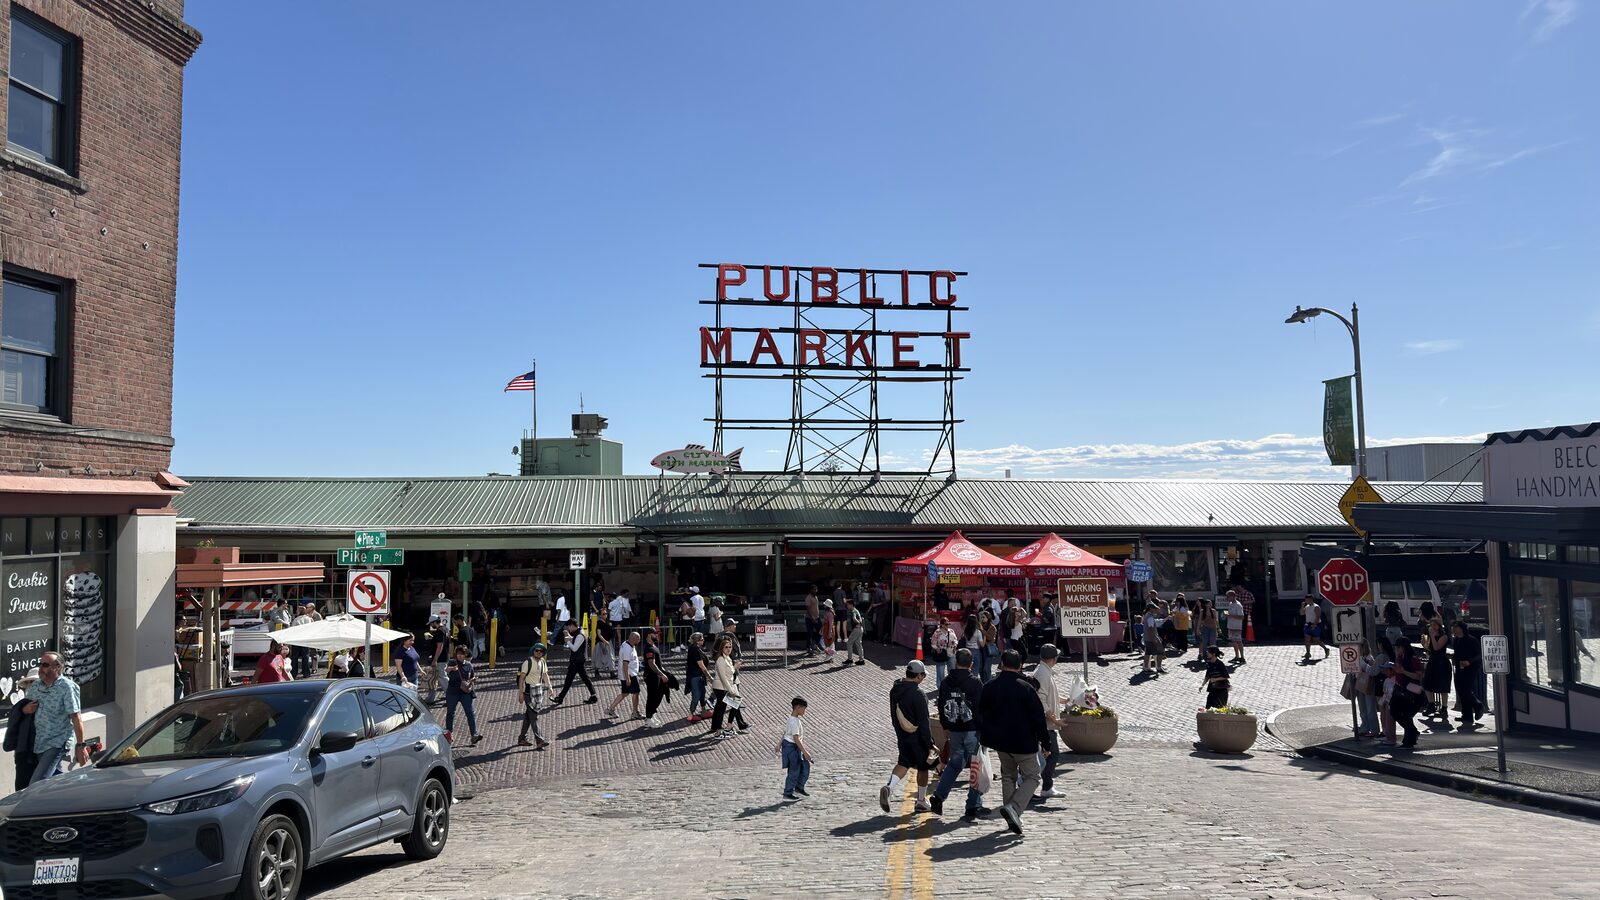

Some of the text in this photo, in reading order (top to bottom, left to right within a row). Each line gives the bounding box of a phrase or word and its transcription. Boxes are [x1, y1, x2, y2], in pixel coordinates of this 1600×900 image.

[718, 263, 957, 306] PUBLIC
[700, 326, 971, 369] MARKET
[1325, 384, 1336, 457] WELKOM
[683, 451, 713, 459] CITY
[1554, 444, 1598, 469] BEEC
[688, 459, 732, 467] MARKET
[1353, 485, 1369, 493] YIELD
[1516, 475, 1600, 498] HANDMA
[45, 528, 104, 540] WORKS
[362, 532, 374, 545] Pine
[342, 550, 367, 563] Pike
[373, 553, 382, 563] Pl
[945, 567, 975, 575] ORGANIC
[976, 567, 998, 575] APPLE
[1000, 567, 1021, 576] CIDER
[1046, 567, 1120, 577] ORGANIC APPLE CIDER
[8, 571, 49, 589] Cookie
[1322, 573, 1365, 592] STOP
[1064, 583, 1102, 593] WORKING
[1066, 594, 1101, 603] MARKET
[8, 597, 48, 614] Power
[1063, 610, 1107, 618] AUTHORIZED
[1069, 618, 1102, 626] VEHICLES
[1076, 627, 1095, 635] ONLY
[1336, 633, 1360, 642] ONLY
[6, 638, 48, 654] BAKERY
[50, 830, 69, 840] Ford
[36, 864, 77, 880] CHN7709
[32, 877, 77, 885] SOUNDFORD.COM
